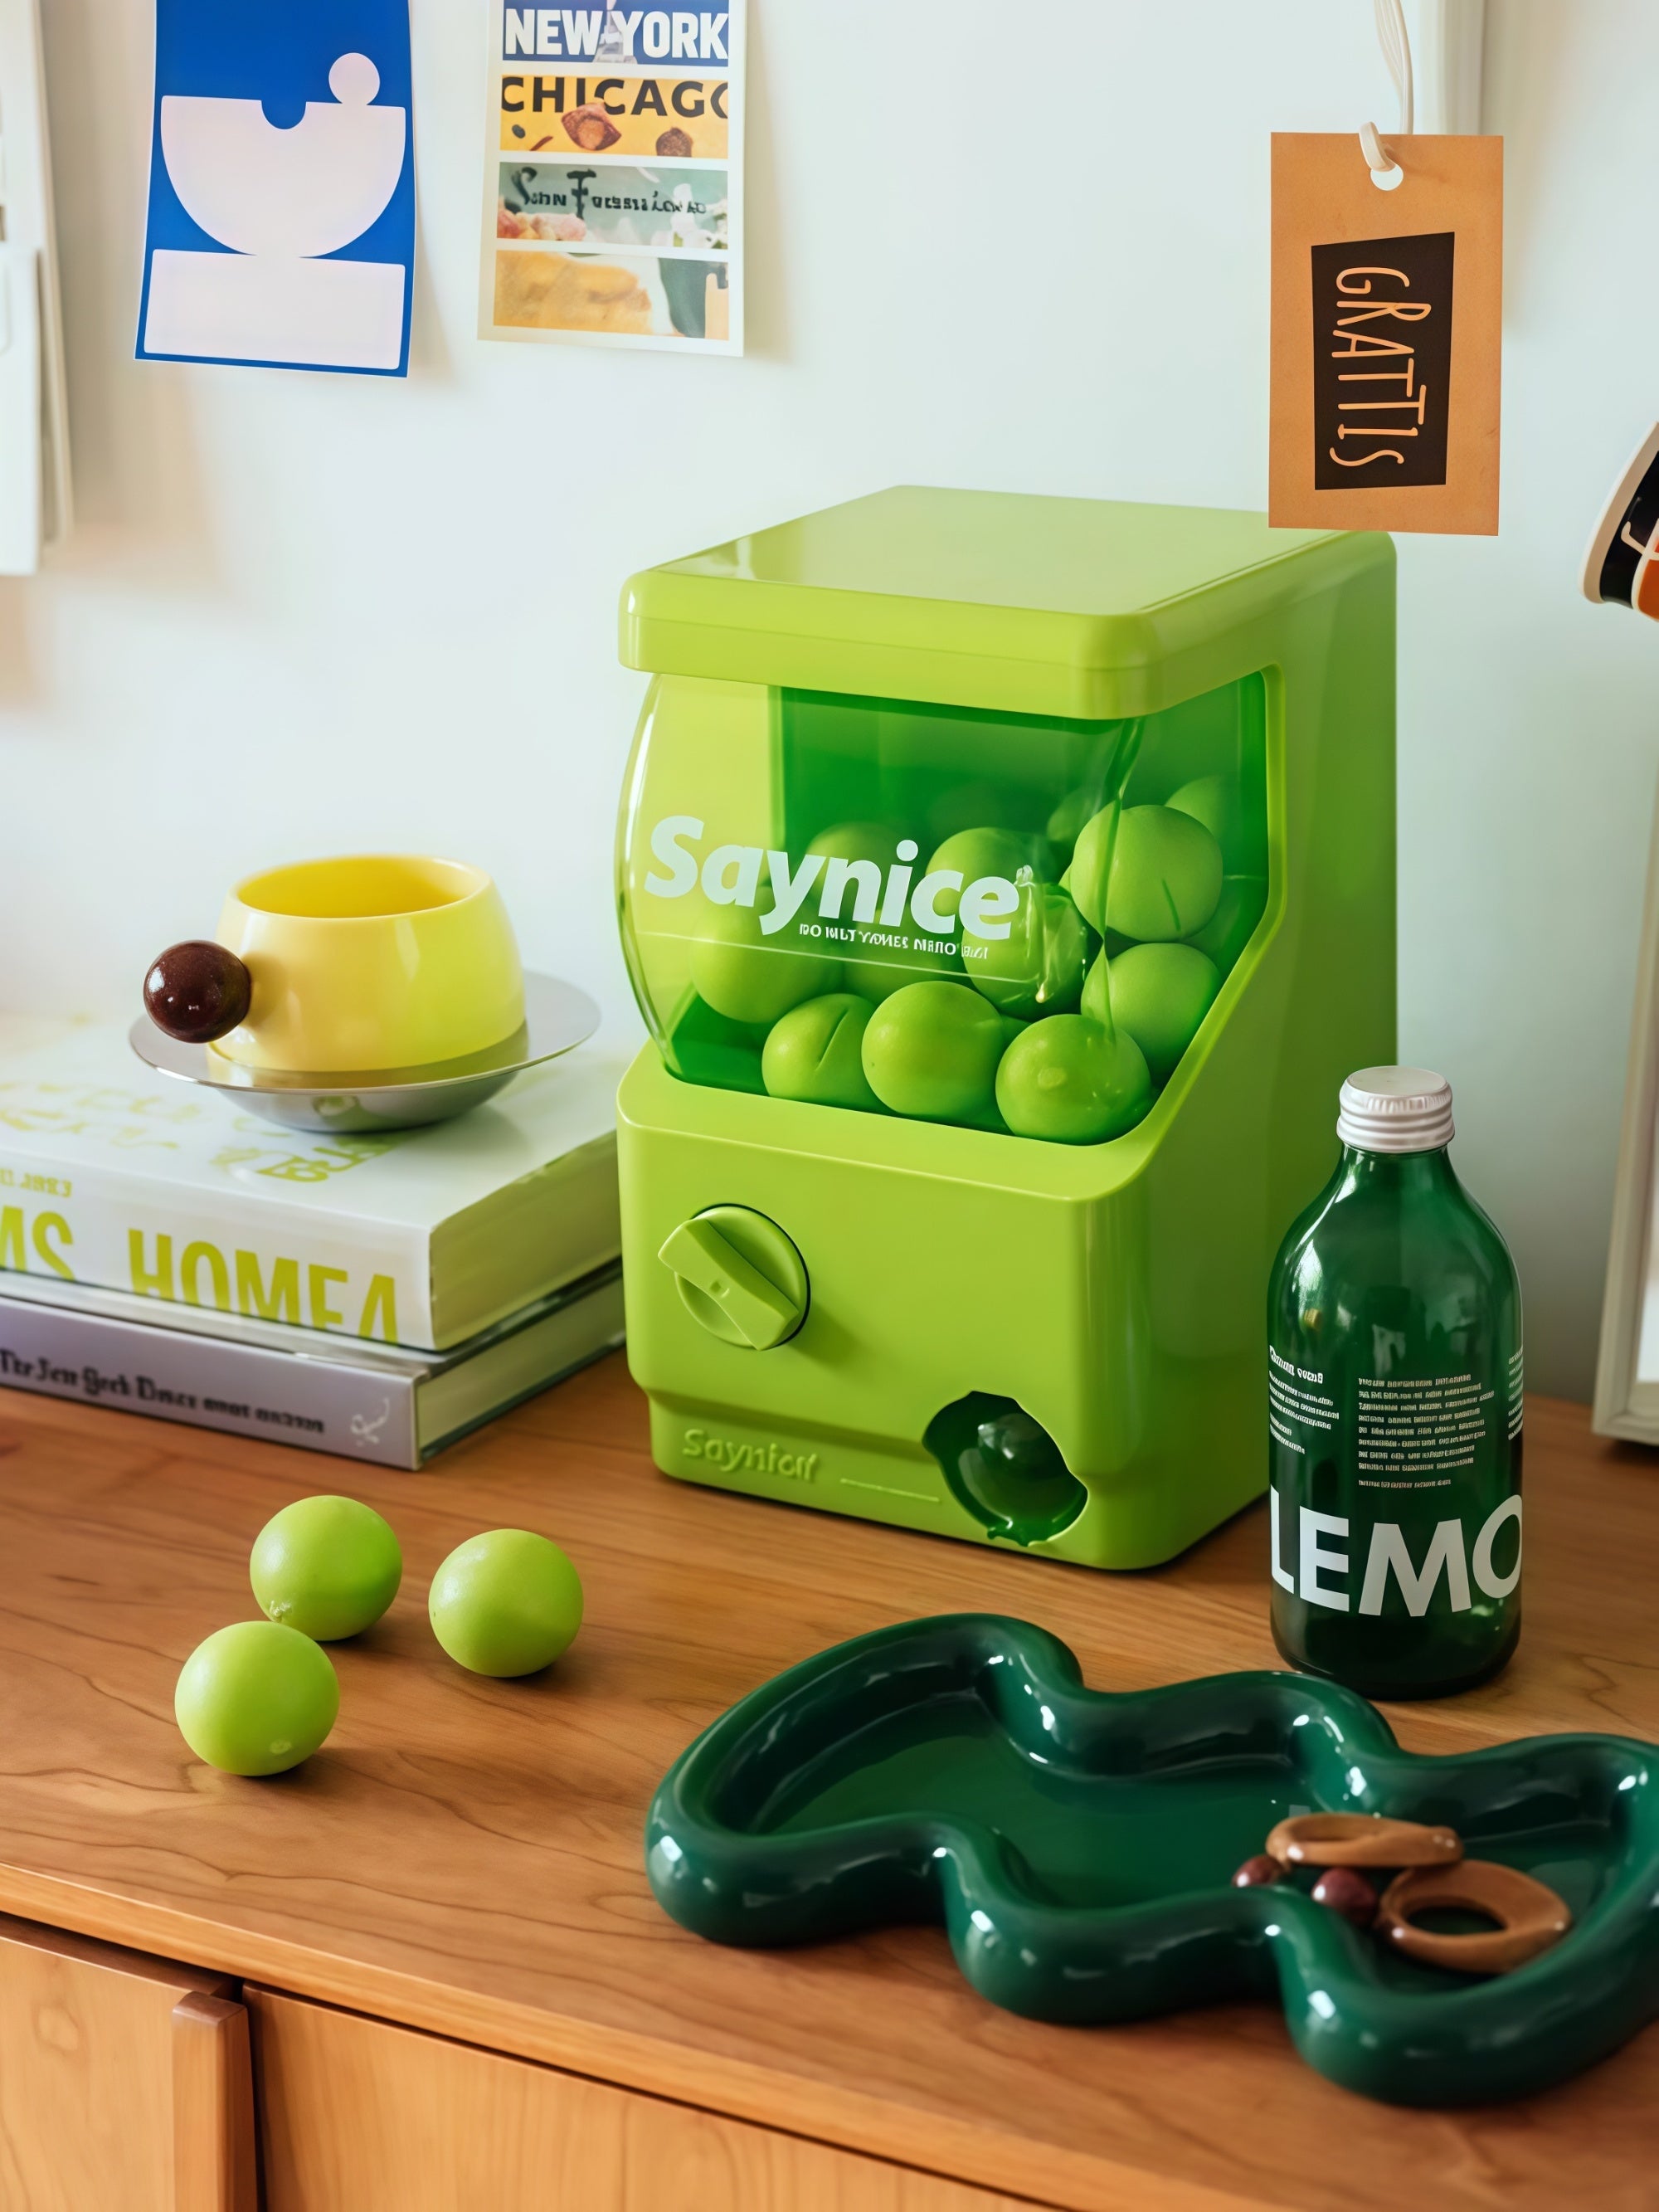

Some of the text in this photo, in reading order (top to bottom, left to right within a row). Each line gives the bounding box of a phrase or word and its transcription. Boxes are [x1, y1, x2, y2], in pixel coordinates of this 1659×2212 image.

[505, 8, 729, 60] NEW YORK
[1330, 266, 1432, 467] GRATTIS
[644, 815, 1020, 940] Saynice
[1270, 1484, 1523, 1617] LEMO
